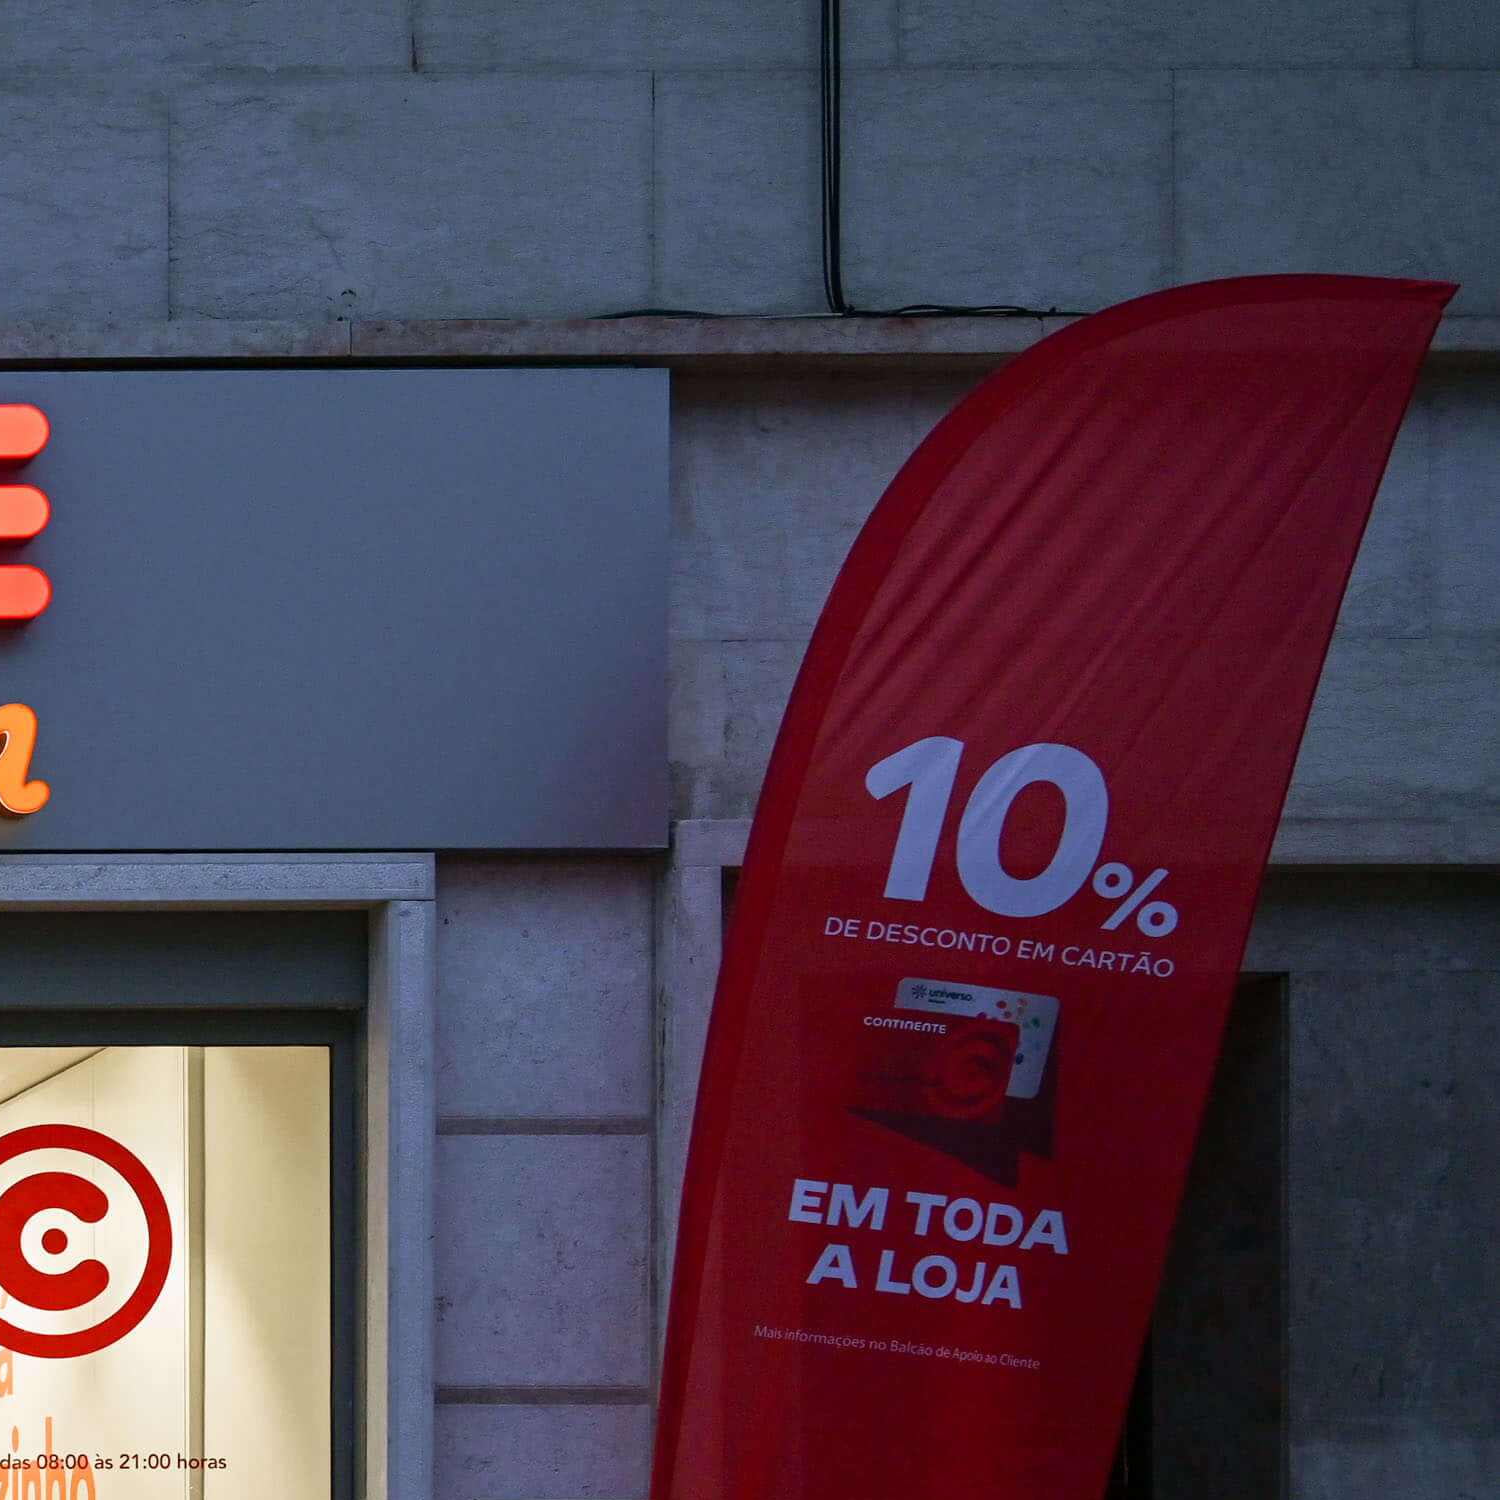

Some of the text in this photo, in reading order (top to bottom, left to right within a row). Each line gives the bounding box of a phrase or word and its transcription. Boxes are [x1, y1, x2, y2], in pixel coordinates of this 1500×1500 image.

[865, 735, 1179, 937] 10%
[825, 917, 1175, 978] DE DESCONTO EM CARTÃO
[928, 988, 974, 1002] universo
[864, 1016, 948, 1034] CONTINENTE
[788, 1178, 1069, 1255] EM TODA
[806, 1243, 1023, 1309] A LOJA
[754, 1325, 1041, 1371] Mais informações no Balcão de Apoio ao Cliente
[0, 1454, 31, 1470] das
[37, 1455, 88, 1470] 08:00
[95, 1454, 113, 1470] às
[119, 1455, 171, 1470] 21:00
[177, 1454, 227, 1470] horas
